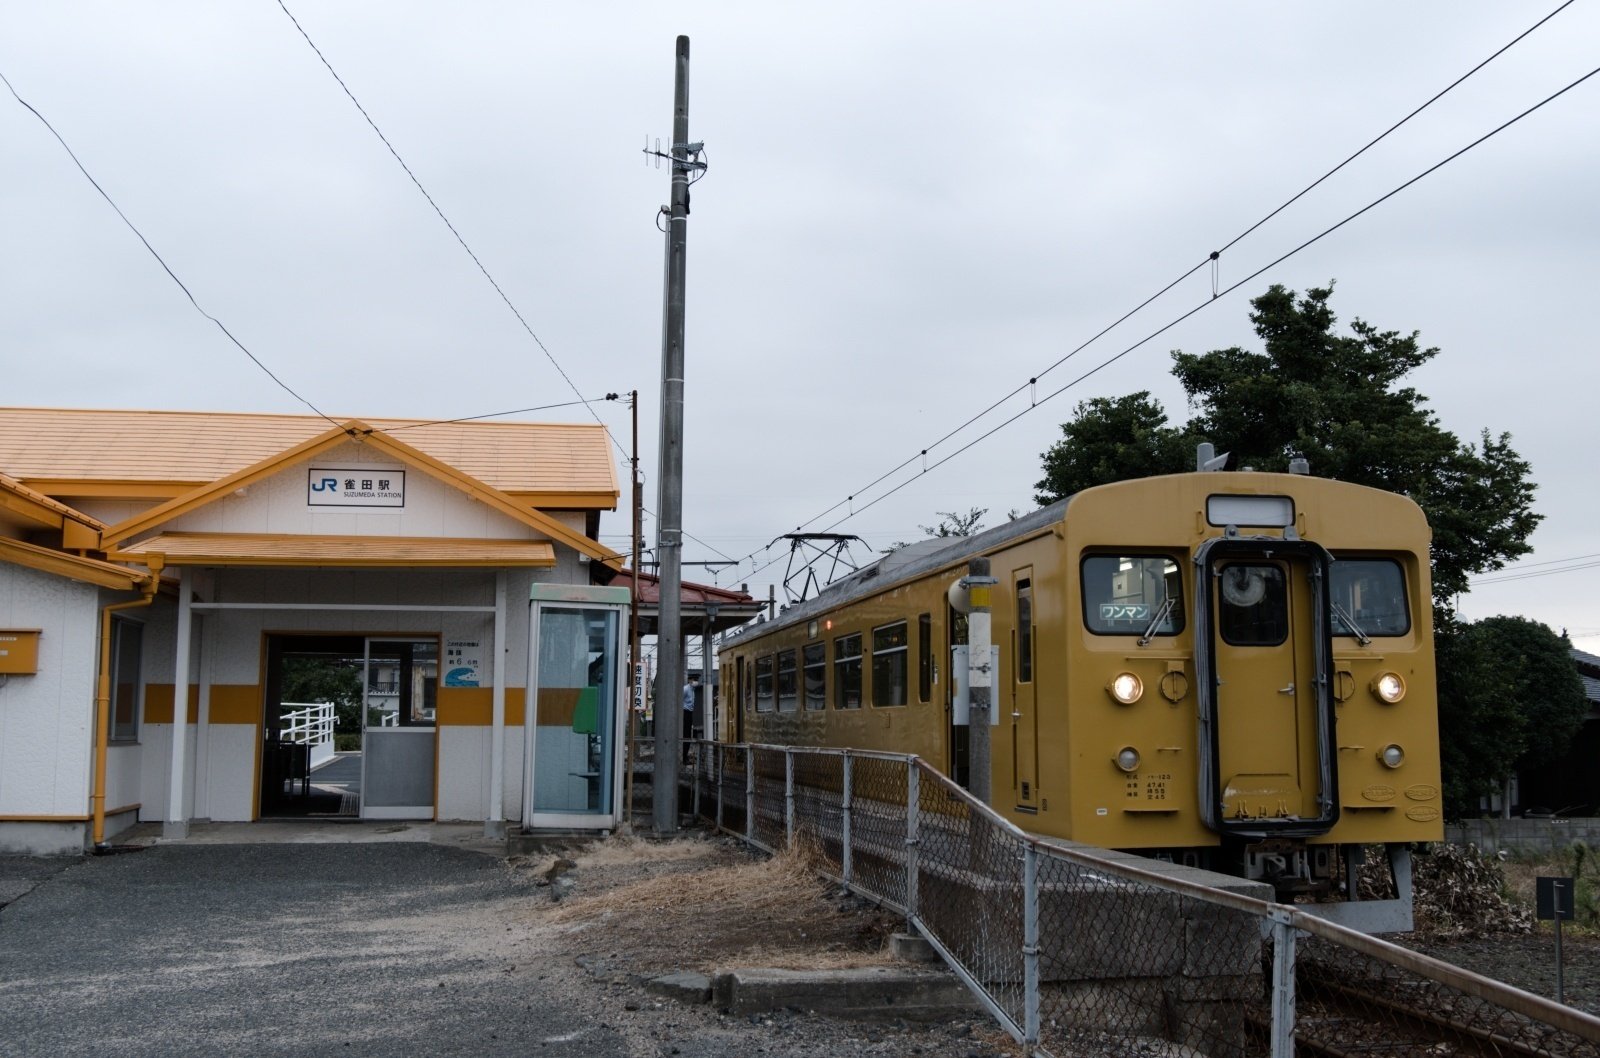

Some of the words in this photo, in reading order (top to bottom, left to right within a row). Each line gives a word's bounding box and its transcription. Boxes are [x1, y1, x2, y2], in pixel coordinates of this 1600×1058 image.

[312, 478, 338, 492] JR
[344, 478, 390, 491] 雀田駅
[1102, 606, 1148, 618] ワンマン
